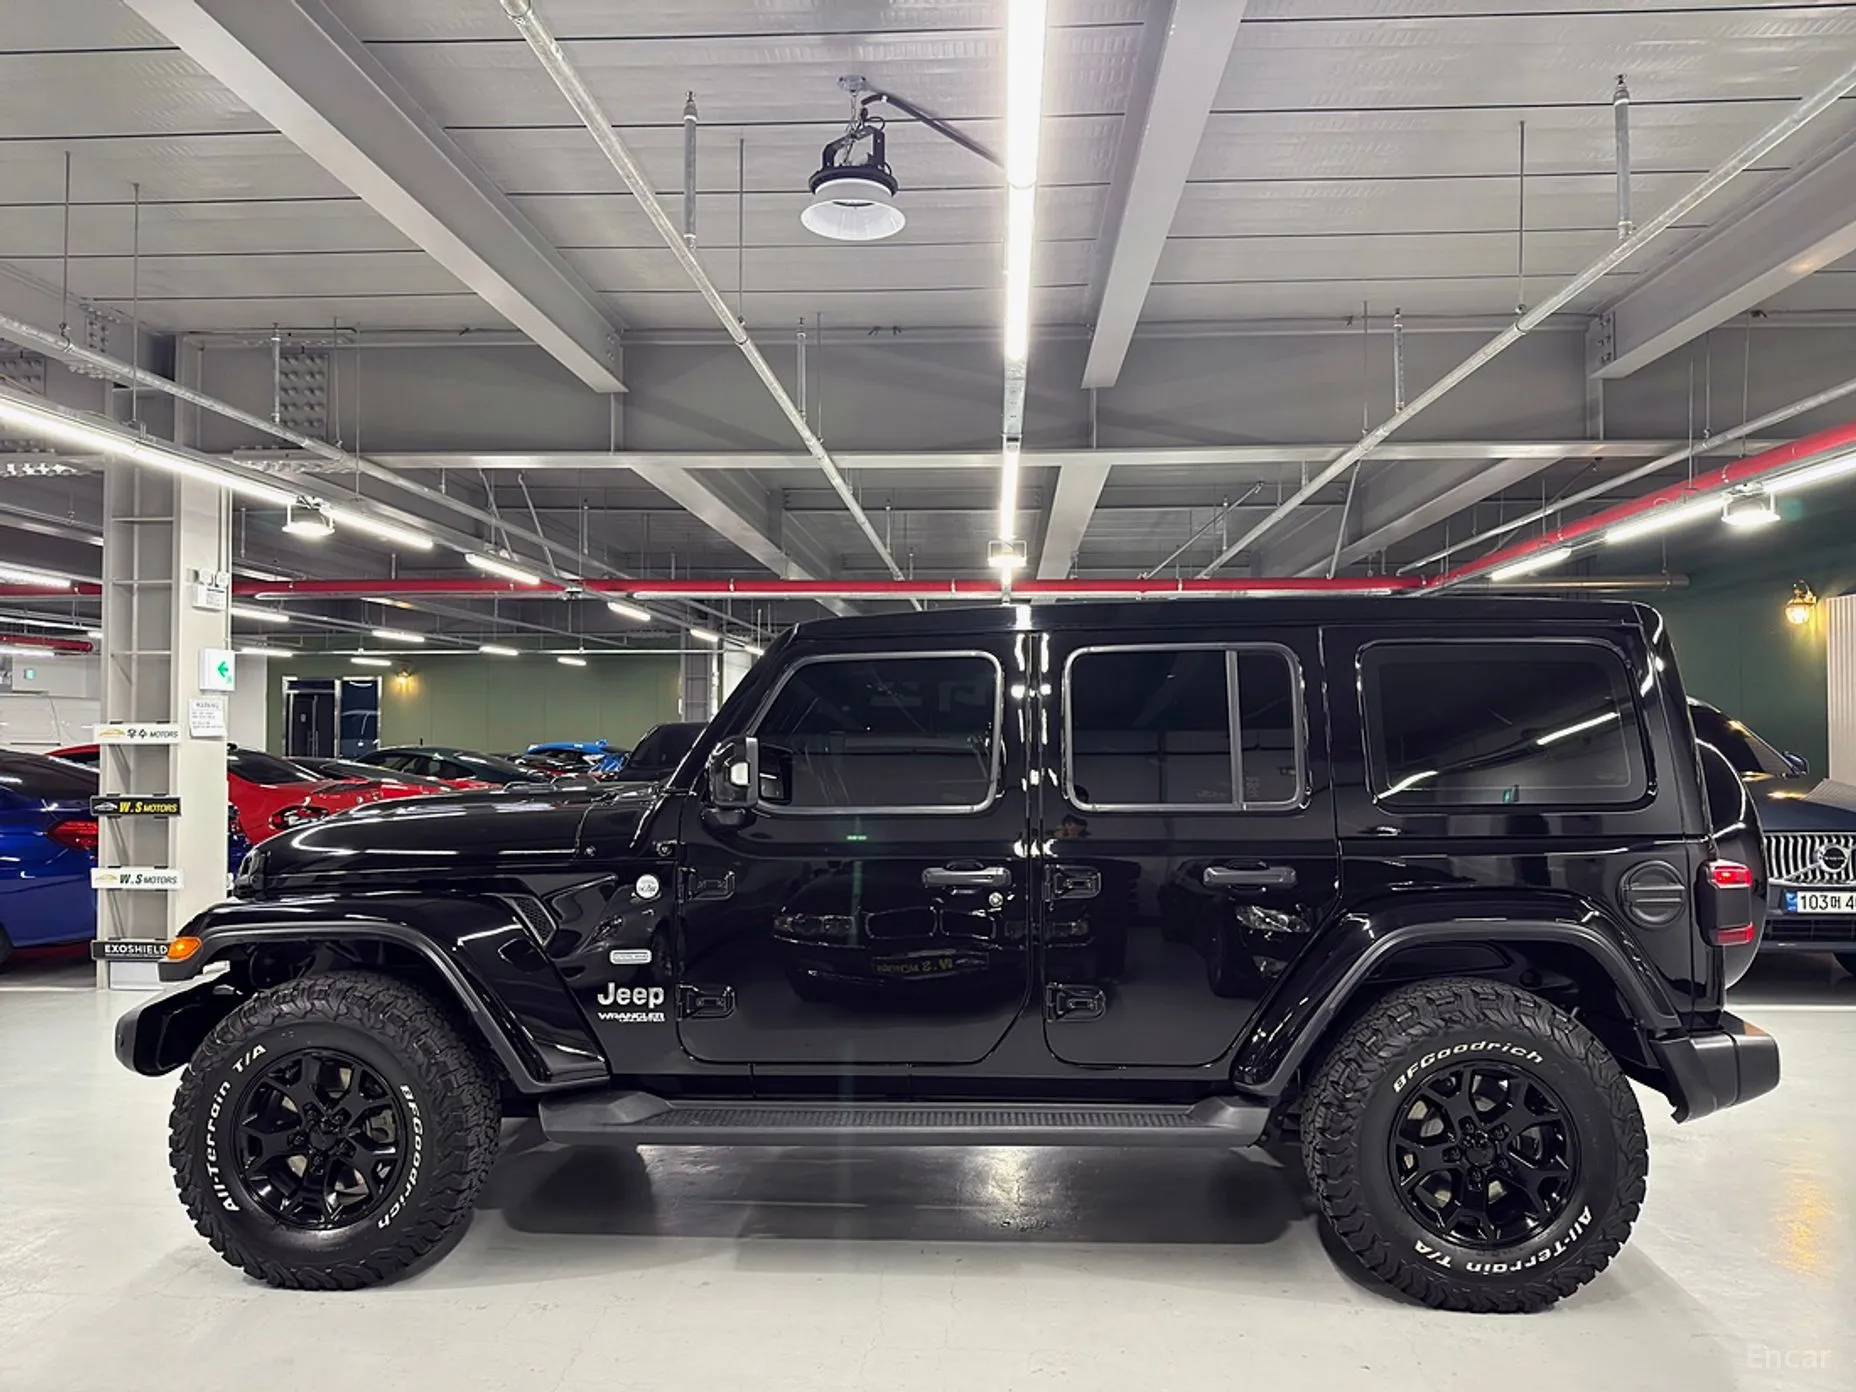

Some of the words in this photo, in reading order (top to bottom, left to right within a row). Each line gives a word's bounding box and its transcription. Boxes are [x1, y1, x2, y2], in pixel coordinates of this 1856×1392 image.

[119, 801, 142, 813] W.S
[143, 804, 177, 813] MOTORS
[120, 874, 142, 884] W.S
[143, 876, 177, 884] MOTORS
[1845, 894, 1856, 910] 4
[104, 944, 168, 954] EXOSHIELD
[597, 982, 664, 1008] Jeep
[597, 1012, 665, 1022] WRANGLER
[1393, 1040, 1544, 1093] BFGoodrich
[205, 1081, 240, 1211] All-Terrain
[232, 1044, 267, 1073] T/A
[378, 1084, 423, 1230] BFGoodrich
[1414, 1239, 1451, 1268] T/A
[1465, 1205, 1593, 1276] All-Terrain
